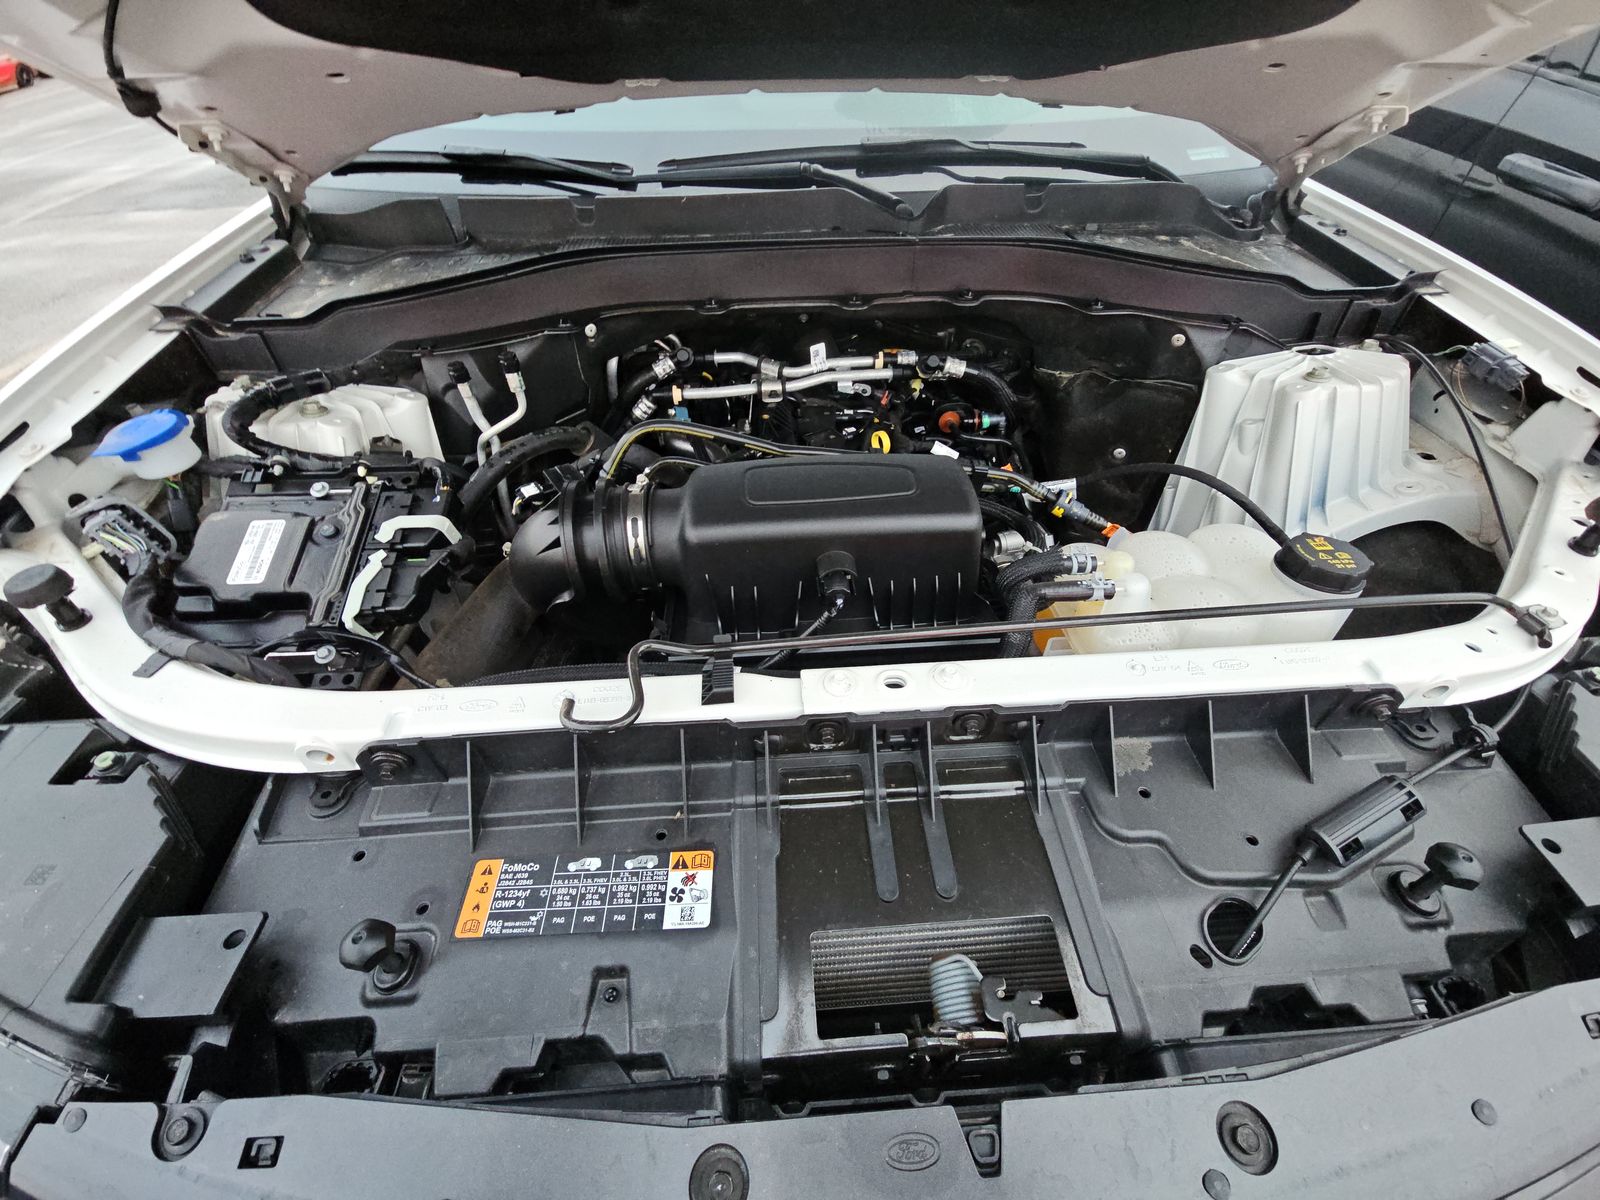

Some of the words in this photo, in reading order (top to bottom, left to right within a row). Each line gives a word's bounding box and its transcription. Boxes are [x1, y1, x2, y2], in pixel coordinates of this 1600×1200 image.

[502, 862, 540, 872] FoMoCo
[495, 889, 531, 899] R-1234yf
[492, 900, 515, 909] (GWP
[516, 900, 525, 908] 4)
